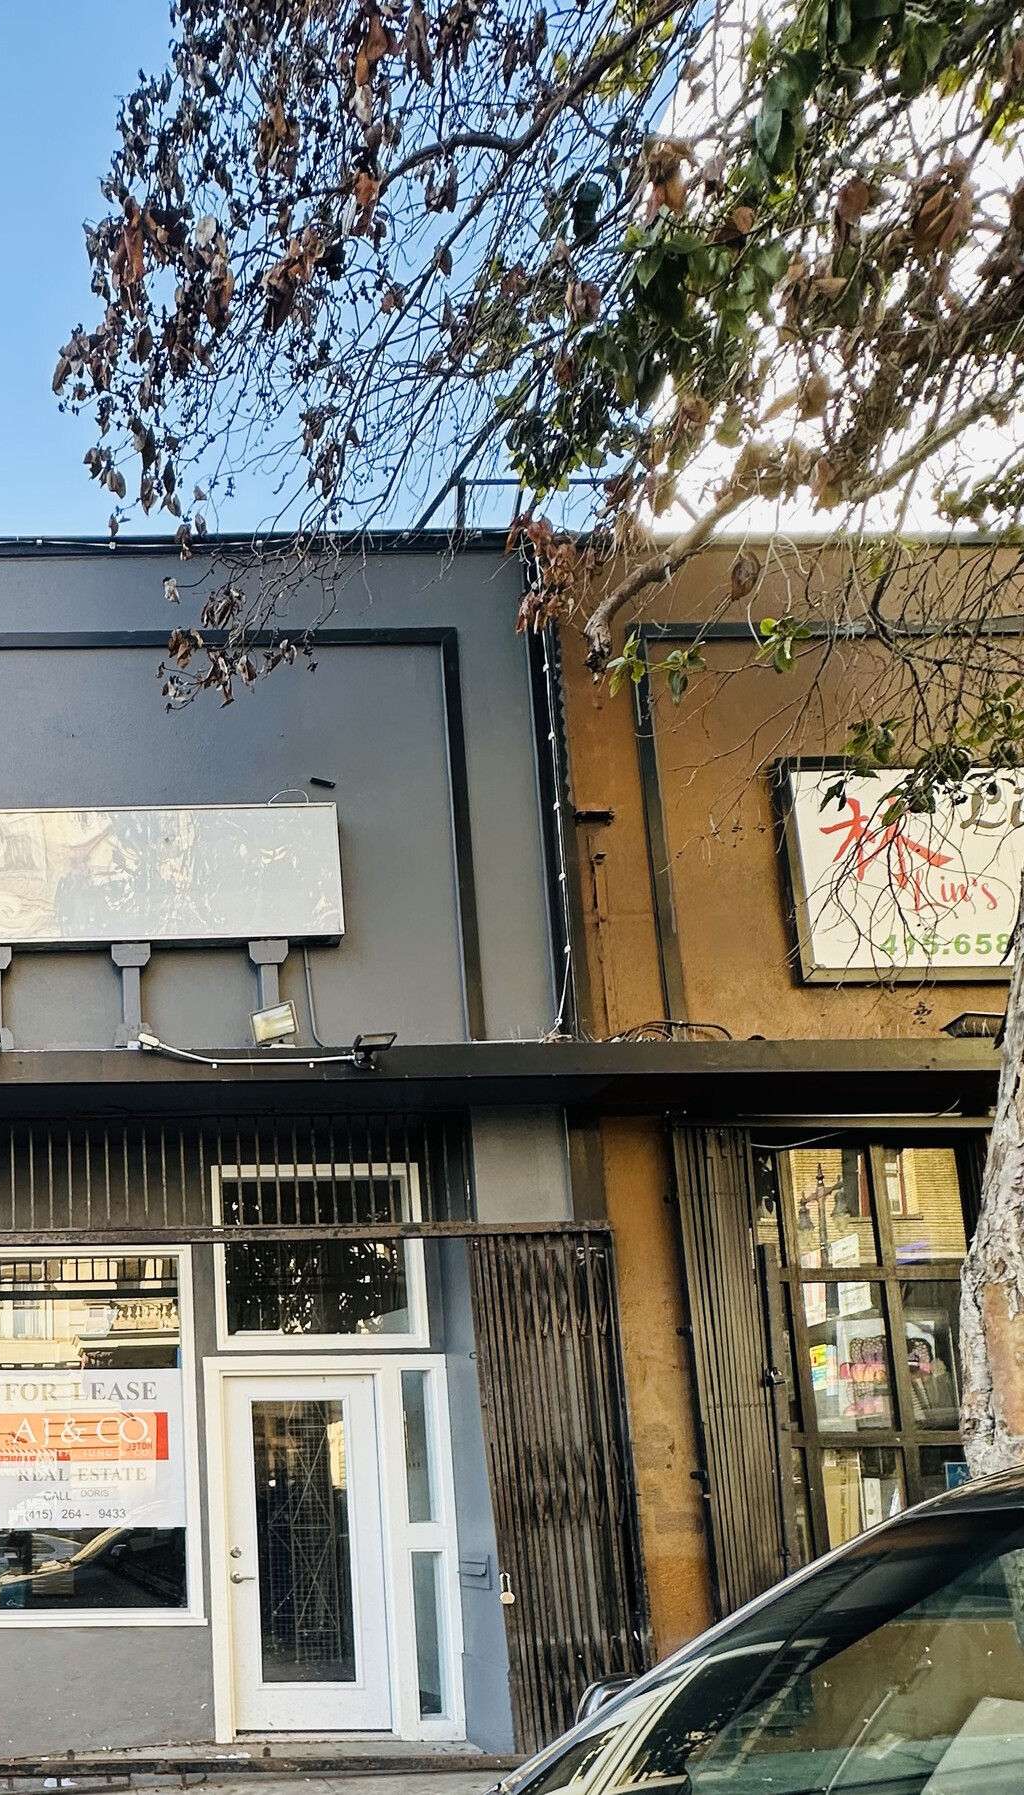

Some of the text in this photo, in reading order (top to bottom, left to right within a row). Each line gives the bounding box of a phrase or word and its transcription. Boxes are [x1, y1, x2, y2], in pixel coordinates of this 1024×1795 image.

[912, 869, 998, 913] Lin's
[6, 1382, 157, 1401] FOR LEASE
[14, 1417, 50, 1447] AJ
[60, 1417, 87, 1444] &
[17, 1467, 147, 1482] REAL ESTATE
[43, 1488, 110, 1500] CALL DORIS
[25, 1508, 53, 1521] (415)
[61, 1509, 81, 1519] 264
[98, 1508, 126, 1519] 9433
